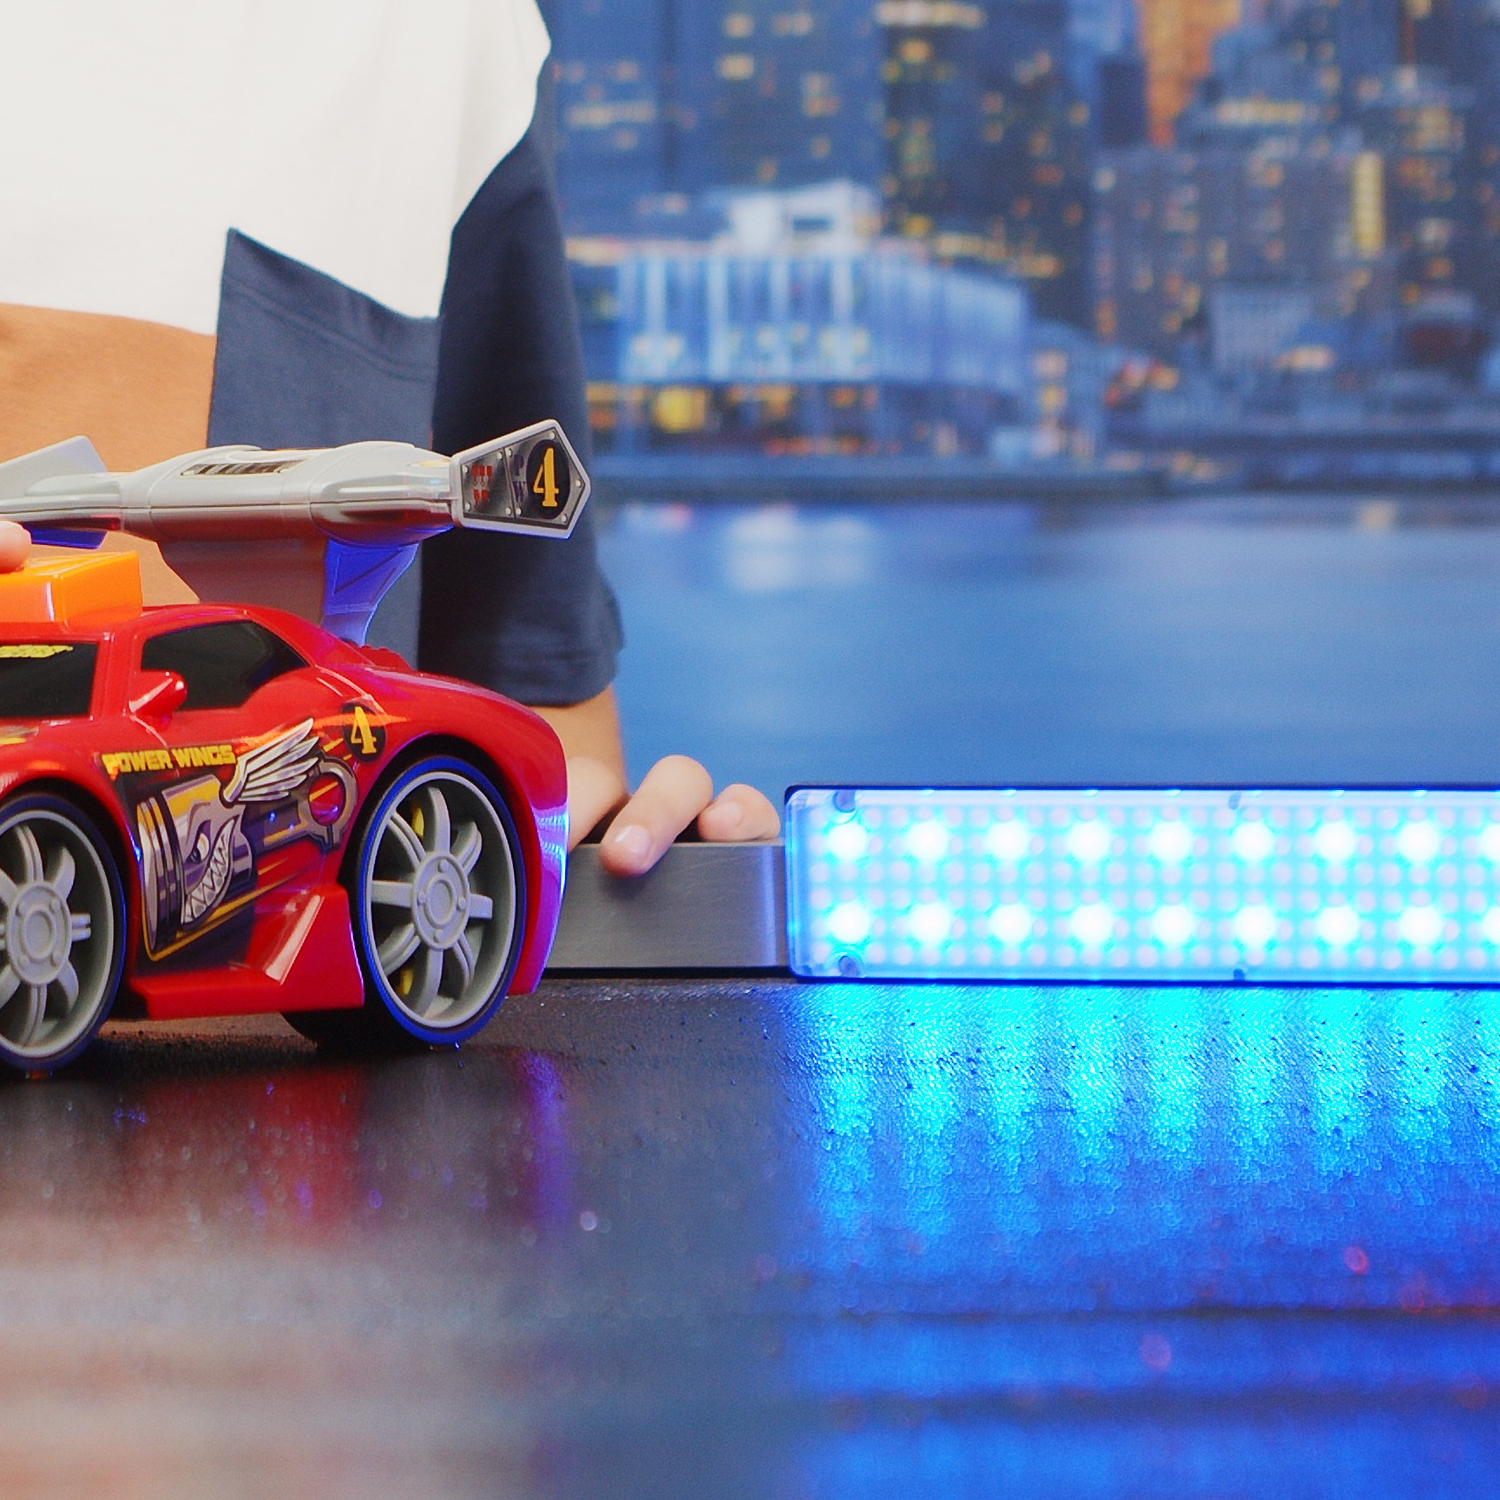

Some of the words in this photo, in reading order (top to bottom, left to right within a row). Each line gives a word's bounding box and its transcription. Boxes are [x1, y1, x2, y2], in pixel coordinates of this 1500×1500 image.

[533, 447, 560, 507] 4
[350, 705, 378, 755] 4
[101, 752, 172, 775] POWER
[171, 744, 237, 768] WINGS
